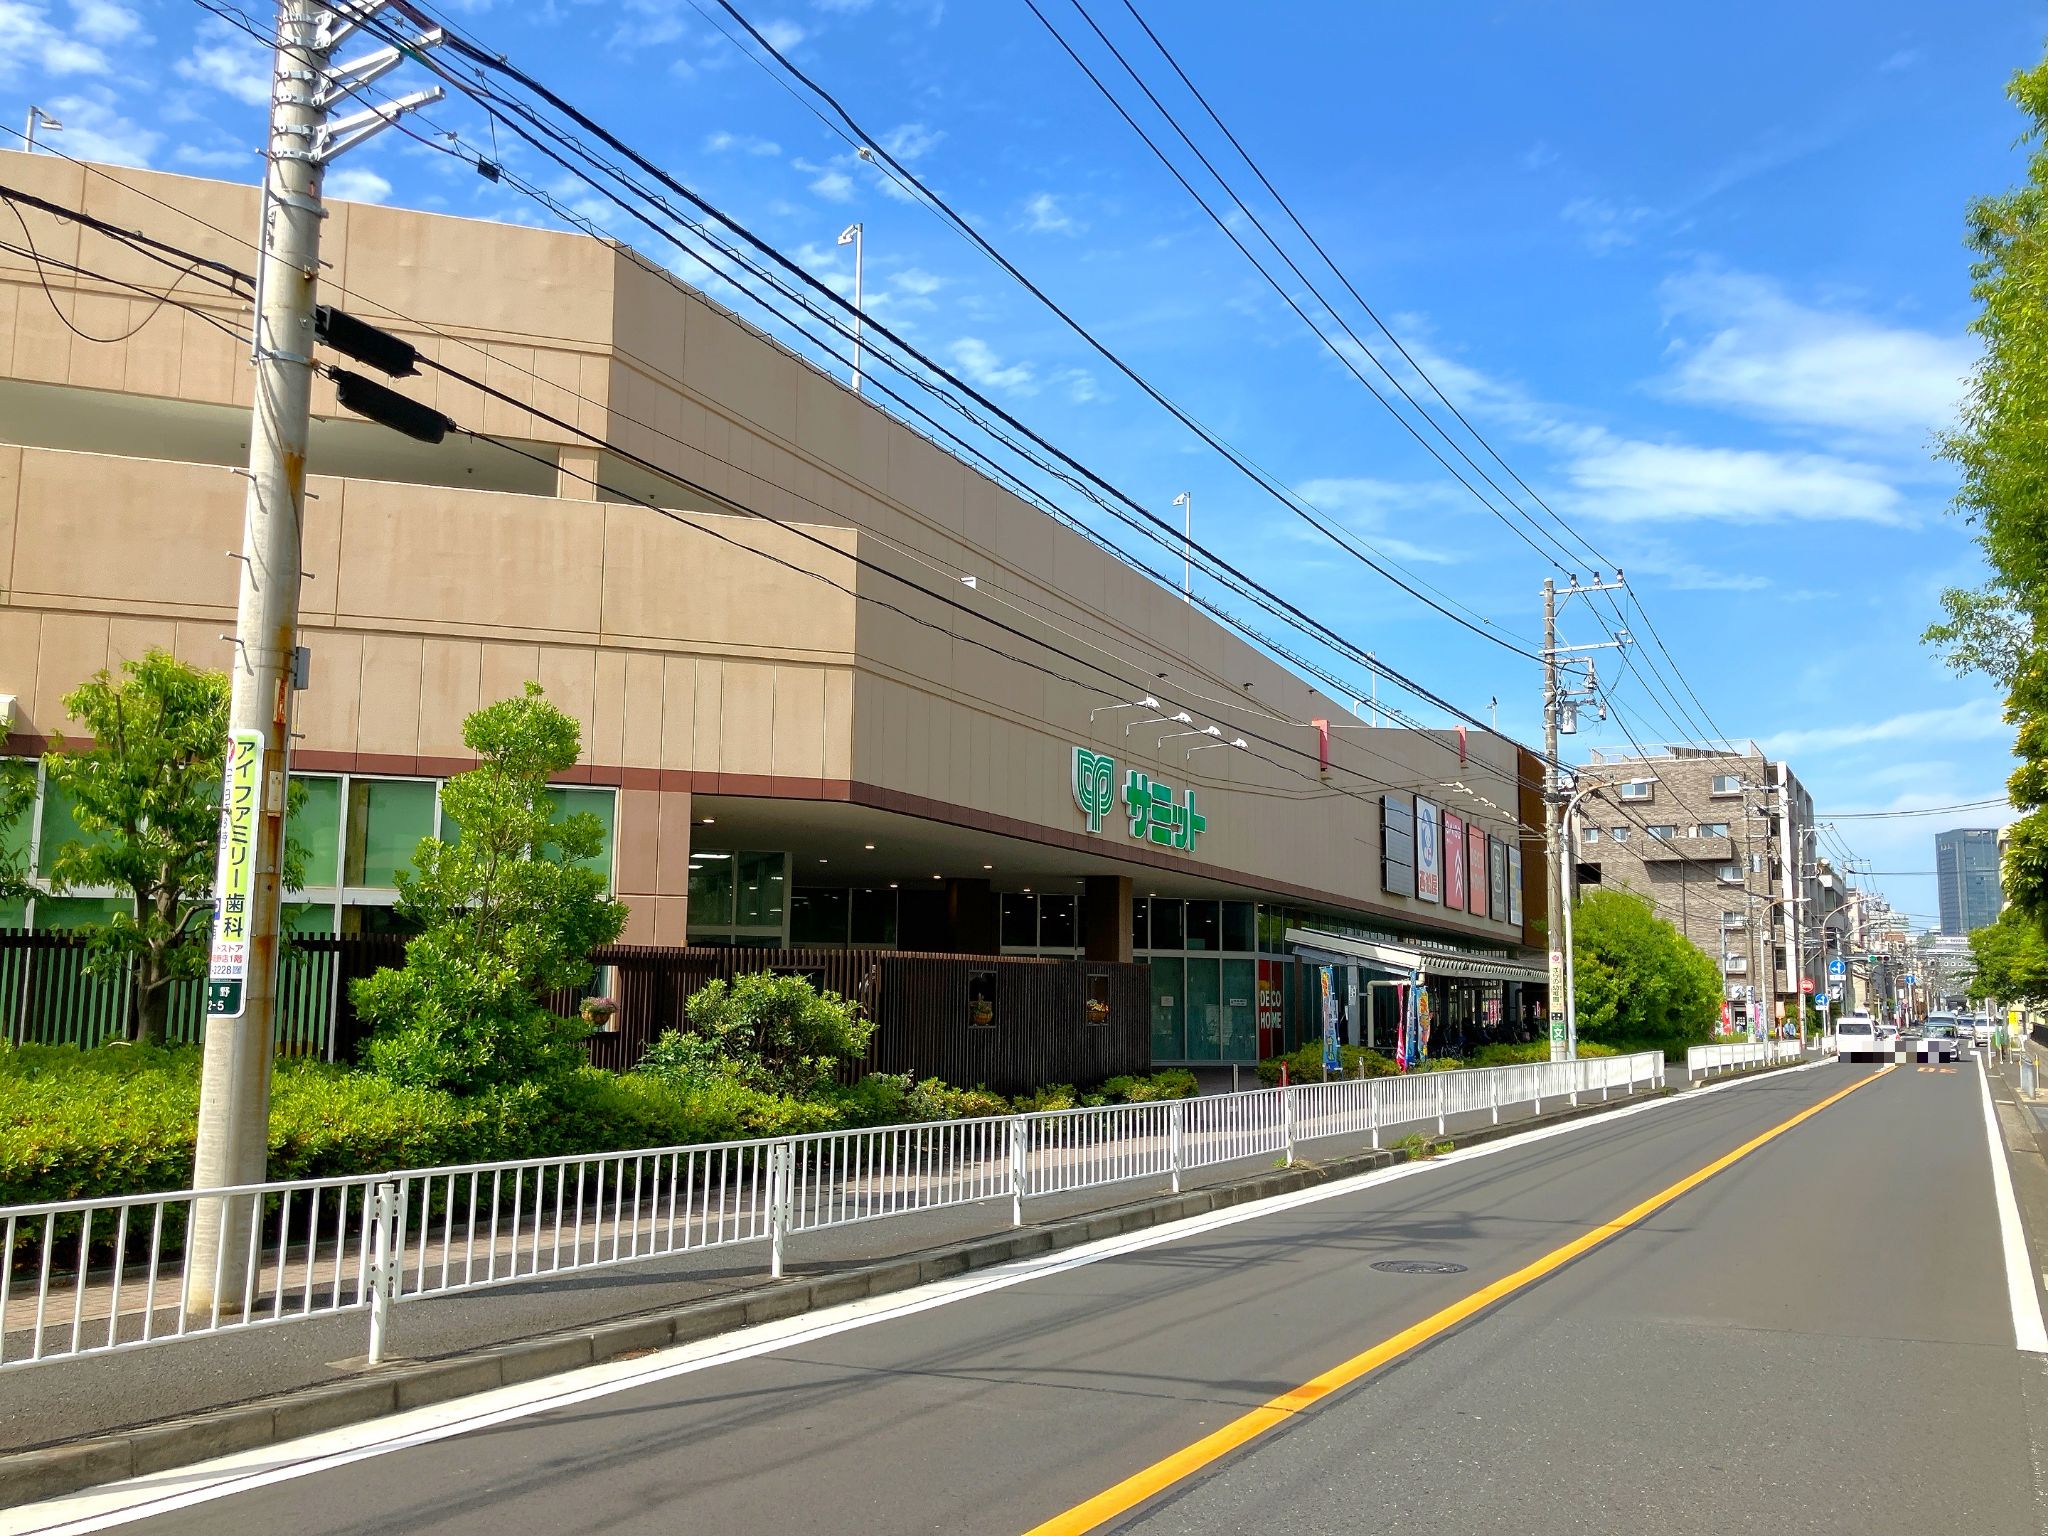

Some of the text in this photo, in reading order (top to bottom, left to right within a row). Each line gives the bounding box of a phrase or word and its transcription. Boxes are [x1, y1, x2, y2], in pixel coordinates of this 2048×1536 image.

[1122, 769, 1206, 852] サミット
[224, 741, 255, 938] アイファミリー歯科
[1260, 990, 1281, 1007] DECO
[1260, 1012, 1282, 1029] HOME
